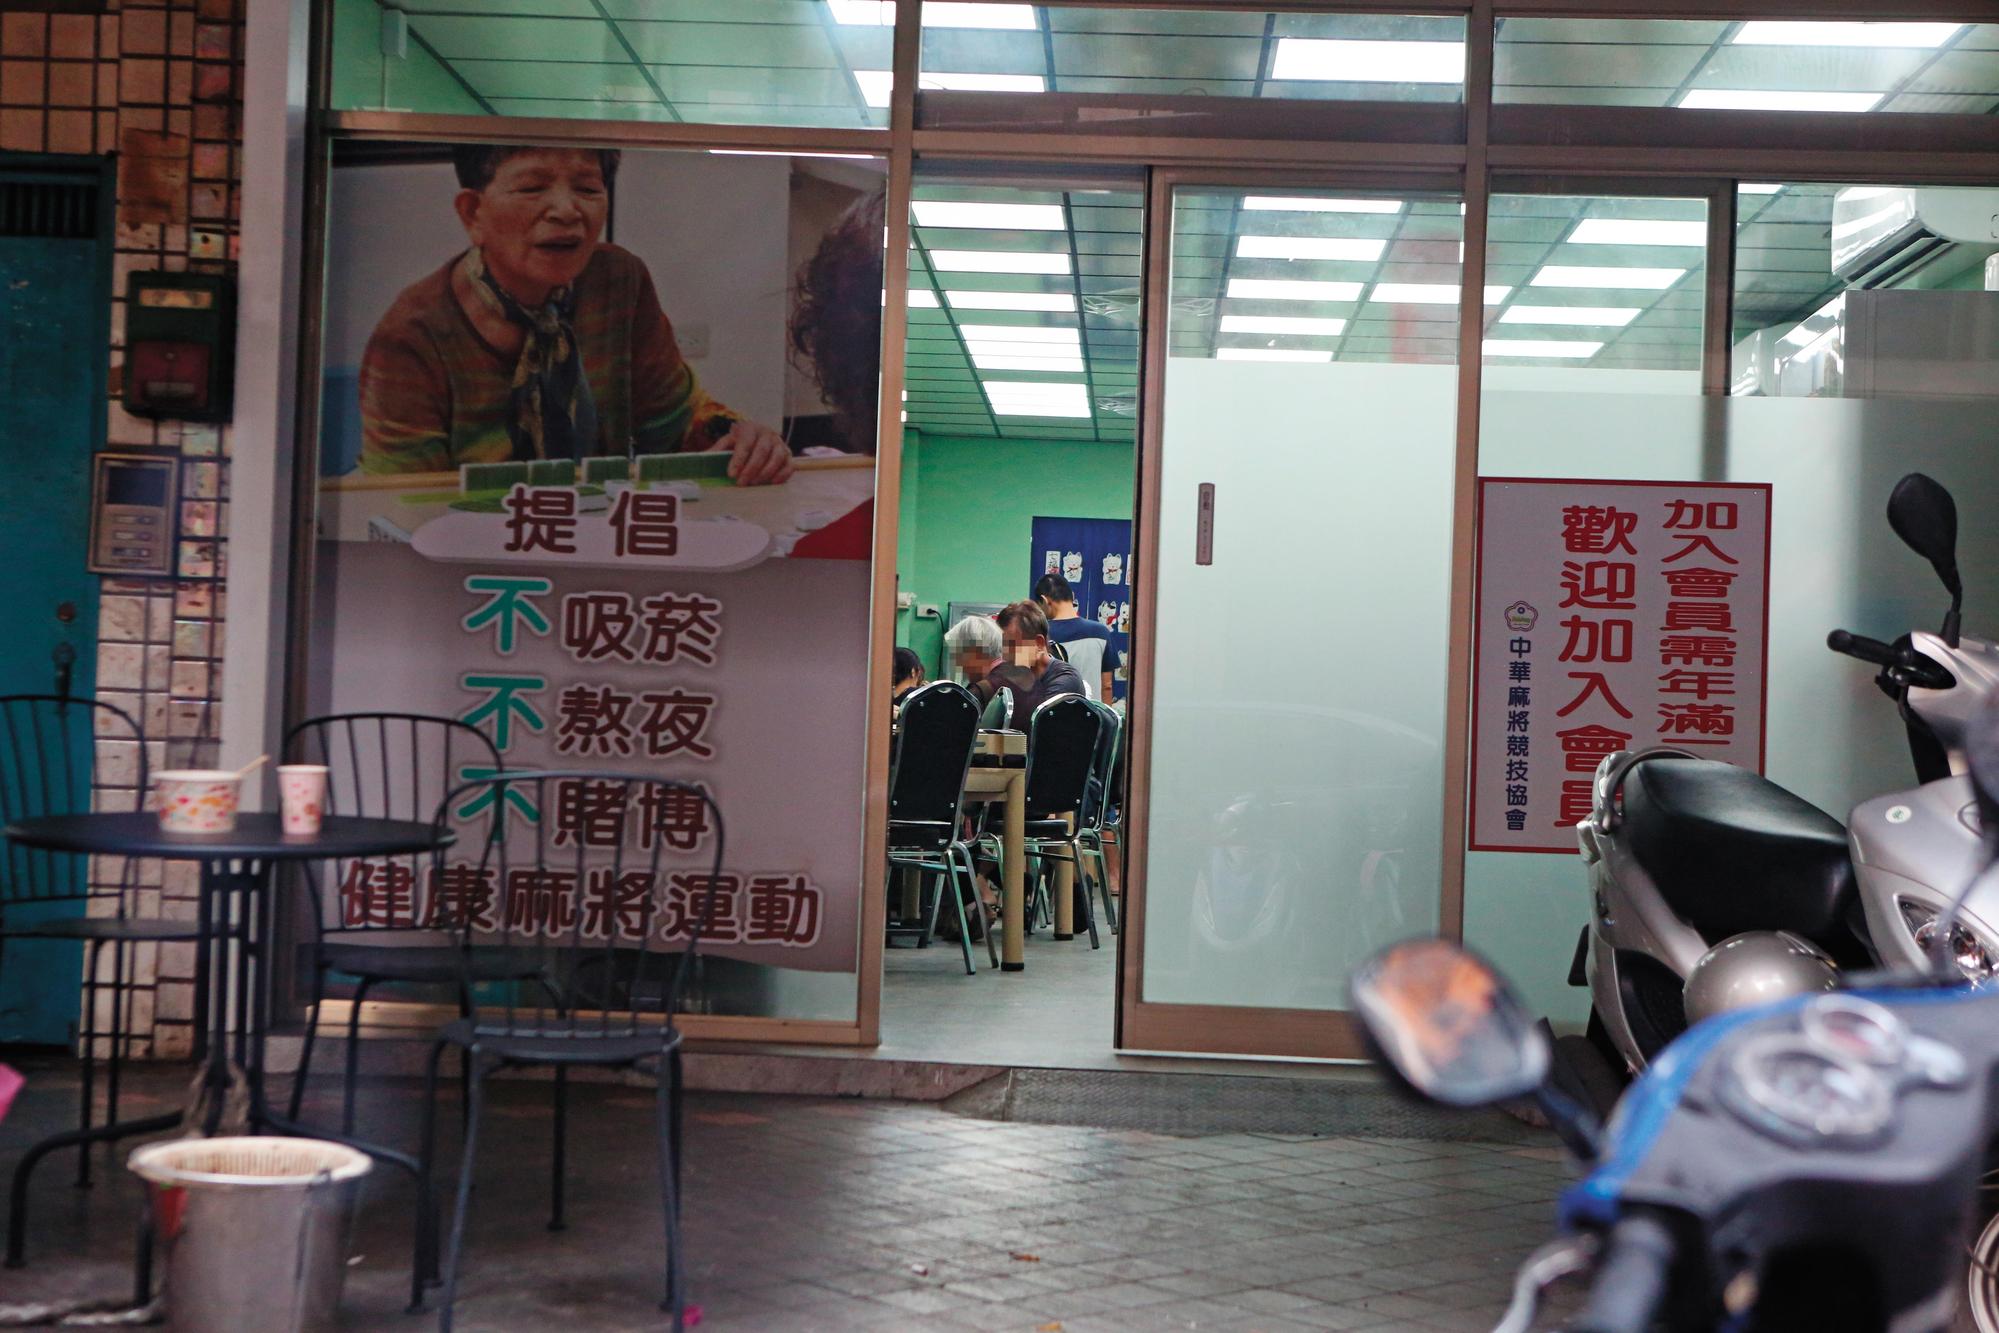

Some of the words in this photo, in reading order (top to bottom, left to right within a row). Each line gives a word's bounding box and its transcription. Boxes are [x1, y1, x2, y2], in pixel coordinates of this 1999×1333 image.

[504, 487, 679, 557] 提倡
[466, 577, 721, 664] 不吸菸
[458, 676, 714, 757] 不熬夜
[1505, 636, 1532, 832] 中華麻將競技協會
[458, 768, 710, 849] 不賭博
[341, 860, 819, 944] 健康麻將運動
